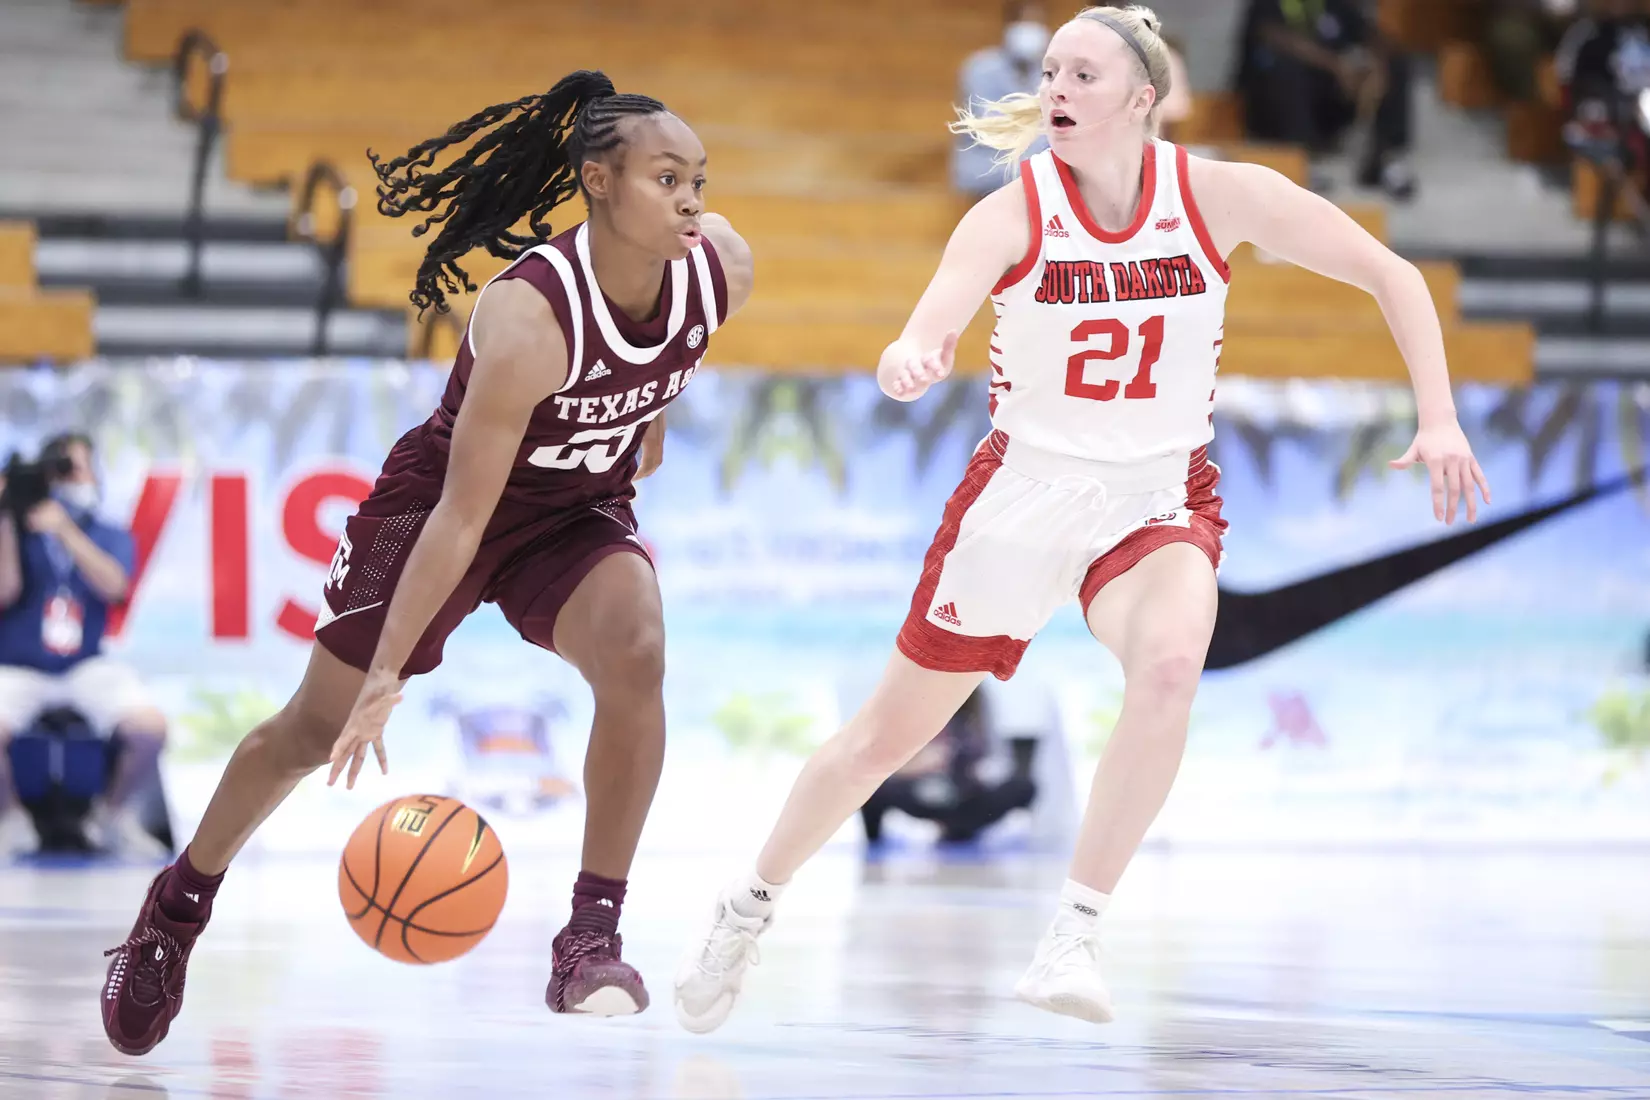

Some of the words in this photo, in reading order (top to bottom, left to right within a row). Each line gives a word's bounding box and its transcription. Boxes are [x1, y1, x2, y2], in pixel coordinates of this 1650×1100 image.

[1035, 260, 1110, 304] SOUTH
[1110, 254, 1206, 301] DAKOTA
[1064, 315, 1165, 401] 21
[554, 380, 659, 424] TEXAS
[933, 609, 962, 627] adidas
